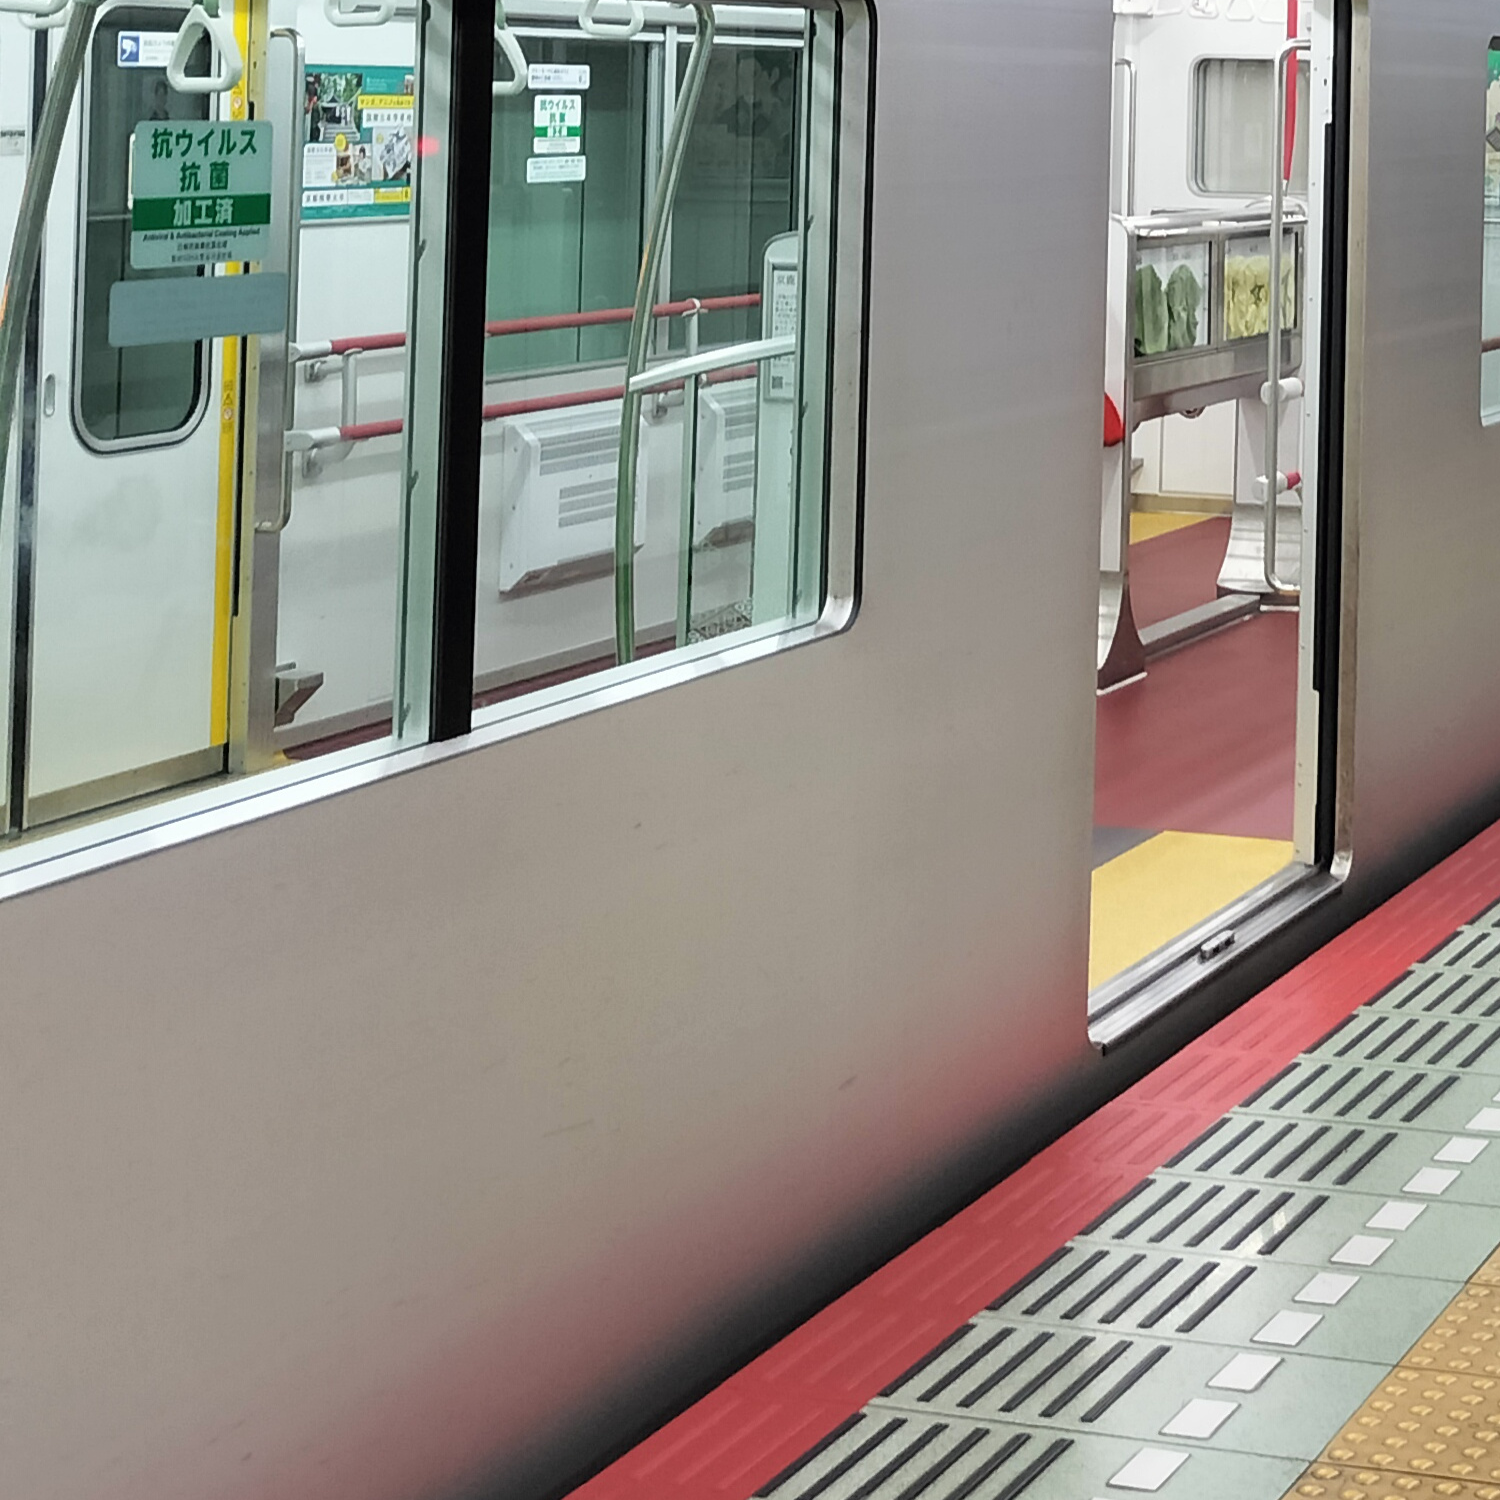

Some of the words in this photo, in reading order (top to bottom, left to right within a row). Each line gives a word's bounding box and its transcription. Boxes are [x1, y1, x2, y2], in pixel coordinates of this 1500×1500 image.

[151, 128, 258, 159] 抗ウイルス
[180, 161, 230, 192] 抗菌
[172, 198, 234, 227] 加工済
